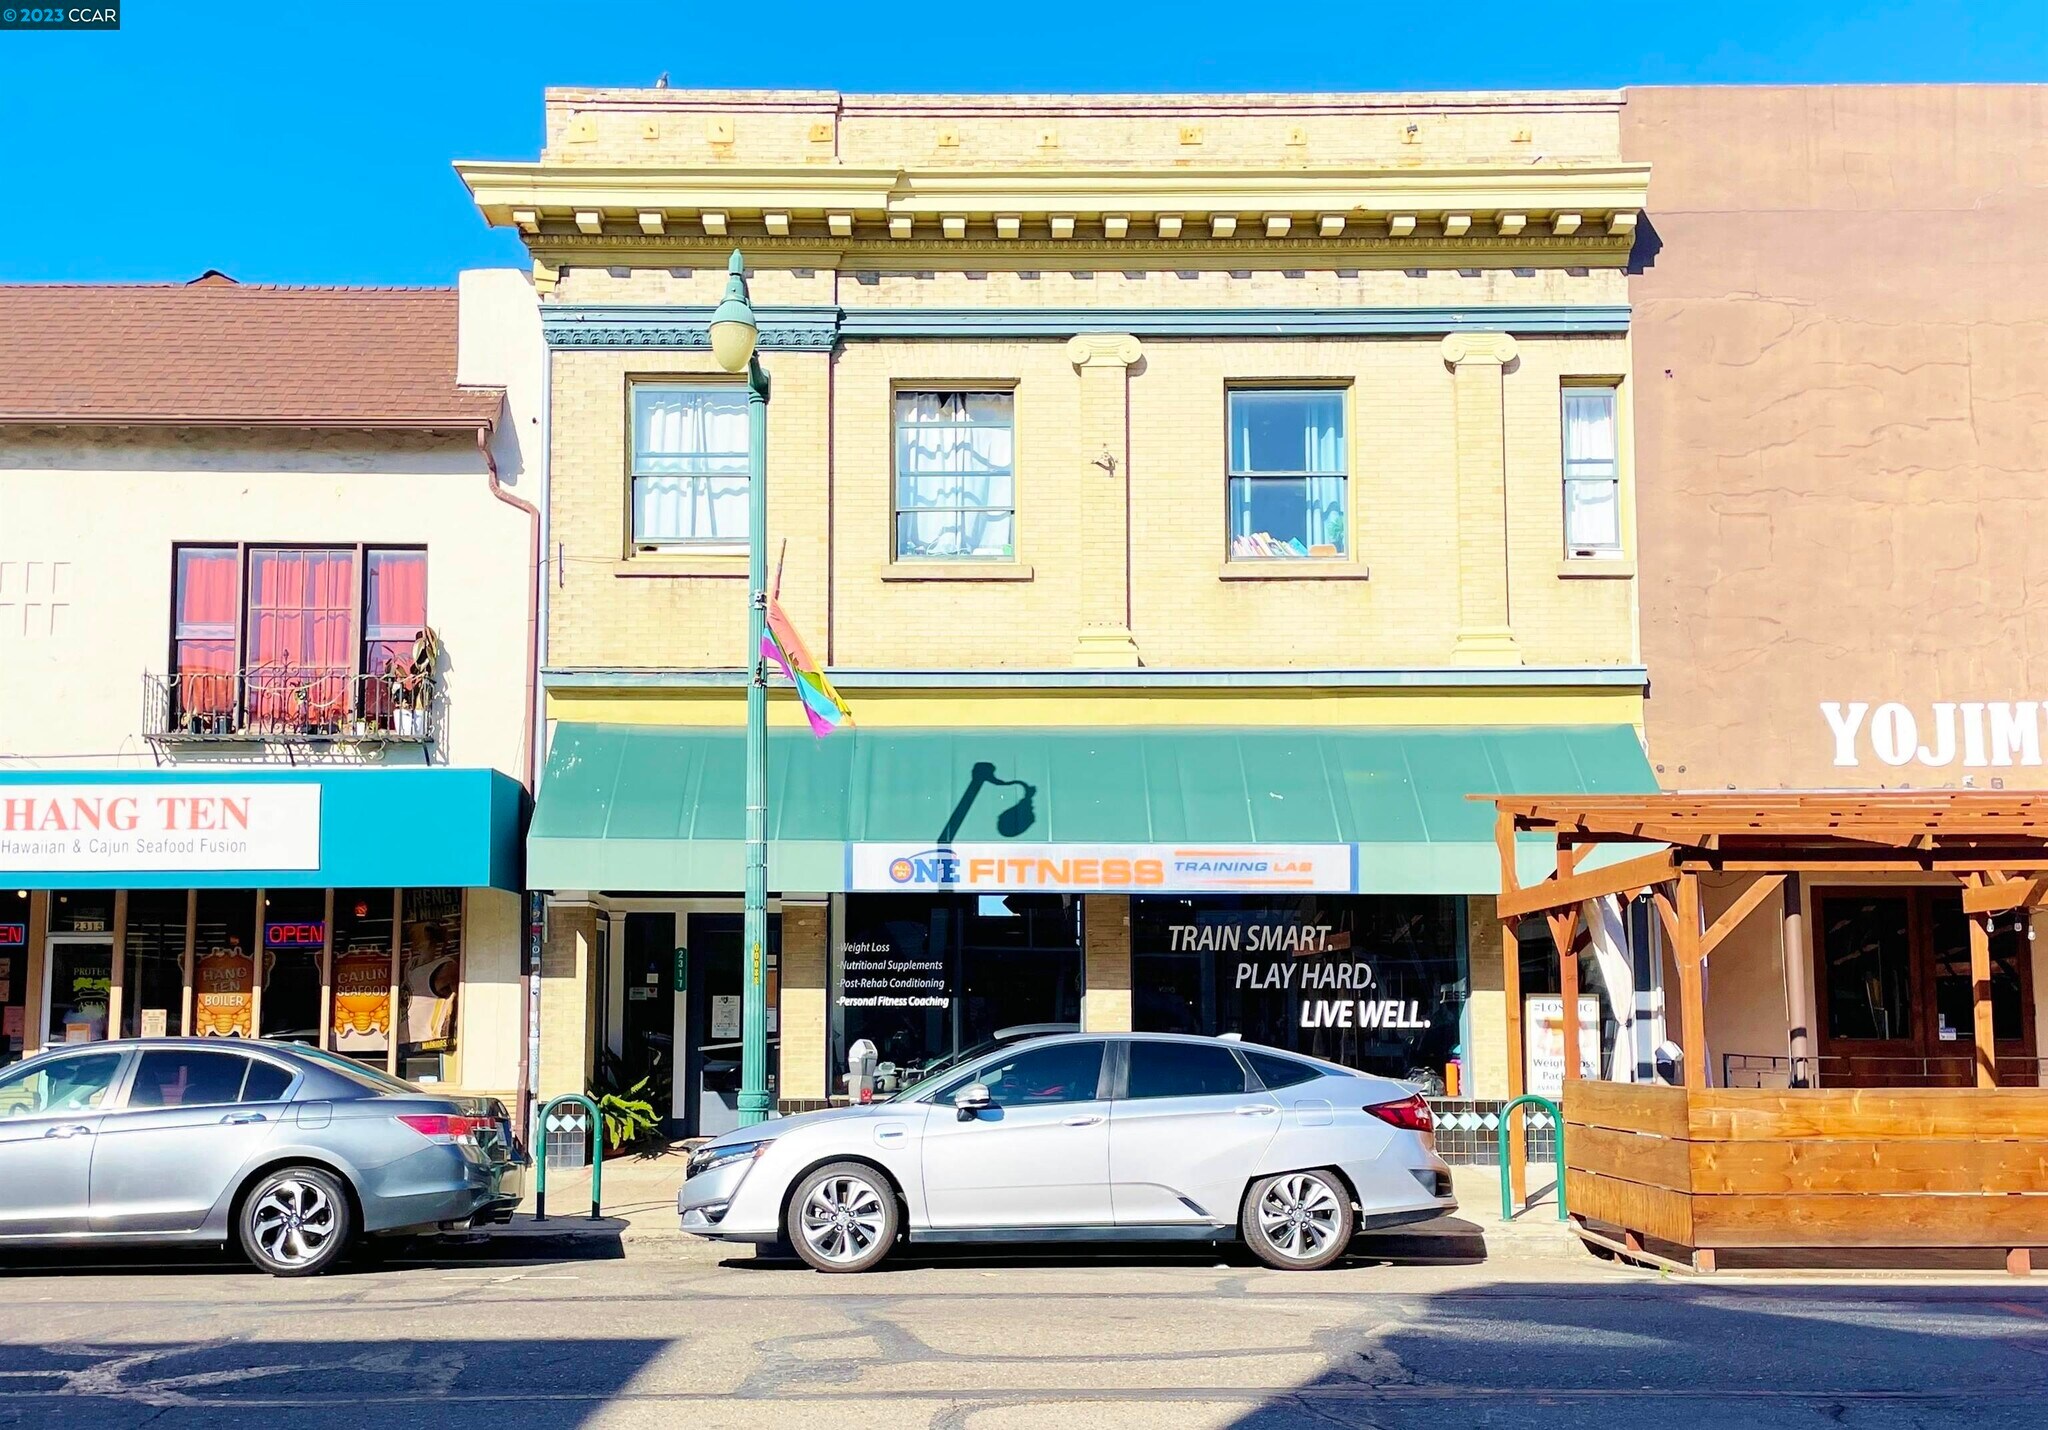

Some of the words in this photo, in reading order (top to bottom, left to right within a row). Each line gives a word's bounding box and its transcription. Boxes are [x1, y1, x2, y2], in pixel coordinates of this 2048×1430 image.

[1820, 701, 2048, 767] YOJIM
[3, 798, 141, 831] HANG
[157, 797, 251, 830] TEN
[1, 839, 65, 854] Hawaiian
[72, 839, 82, 854] &
[89, 838, 129, 856] Cajun
[136, 838, 194, 853] Seafood
[200, 838, 247, 853] Fusion
[969, 858, 1164, 884] FITNESS
[1174, 861, 1268, 872] TRAINING
[1272, 861, 1313, 872] LAB
[76, 922, 103, 931] 2315
[269, 925, 323, 943] OPEN
[1168, 925, 1241, 951] TRAIN
[1246, 925, 1333, 951] SMART.
[871, 943, 890, 952] Loss
[74, 968, 110, 976] PROTEC
[887, 960, 943, 972] Supplements
[203, 967, 247, 980] HANG
[337, 968, 388, 983] CAJUN
[1235, 963, 1297, 989] PLAY
[1301, 963, 1377, 989] HARD.
[212, 981, 241, 992] TEN
[889, 978, 945, 990] Conditioning
[337, 985, 388, 996] SEAFOOD
[204, 995, 244, 1006] BOILER
[877, 996, 907, 1006] Fitness
[908, 996, 949, 1008] Coaching
[1300, 1000, 1354, 1028] LIVE
[1358, 1000, 1431, 1028] WELL.
